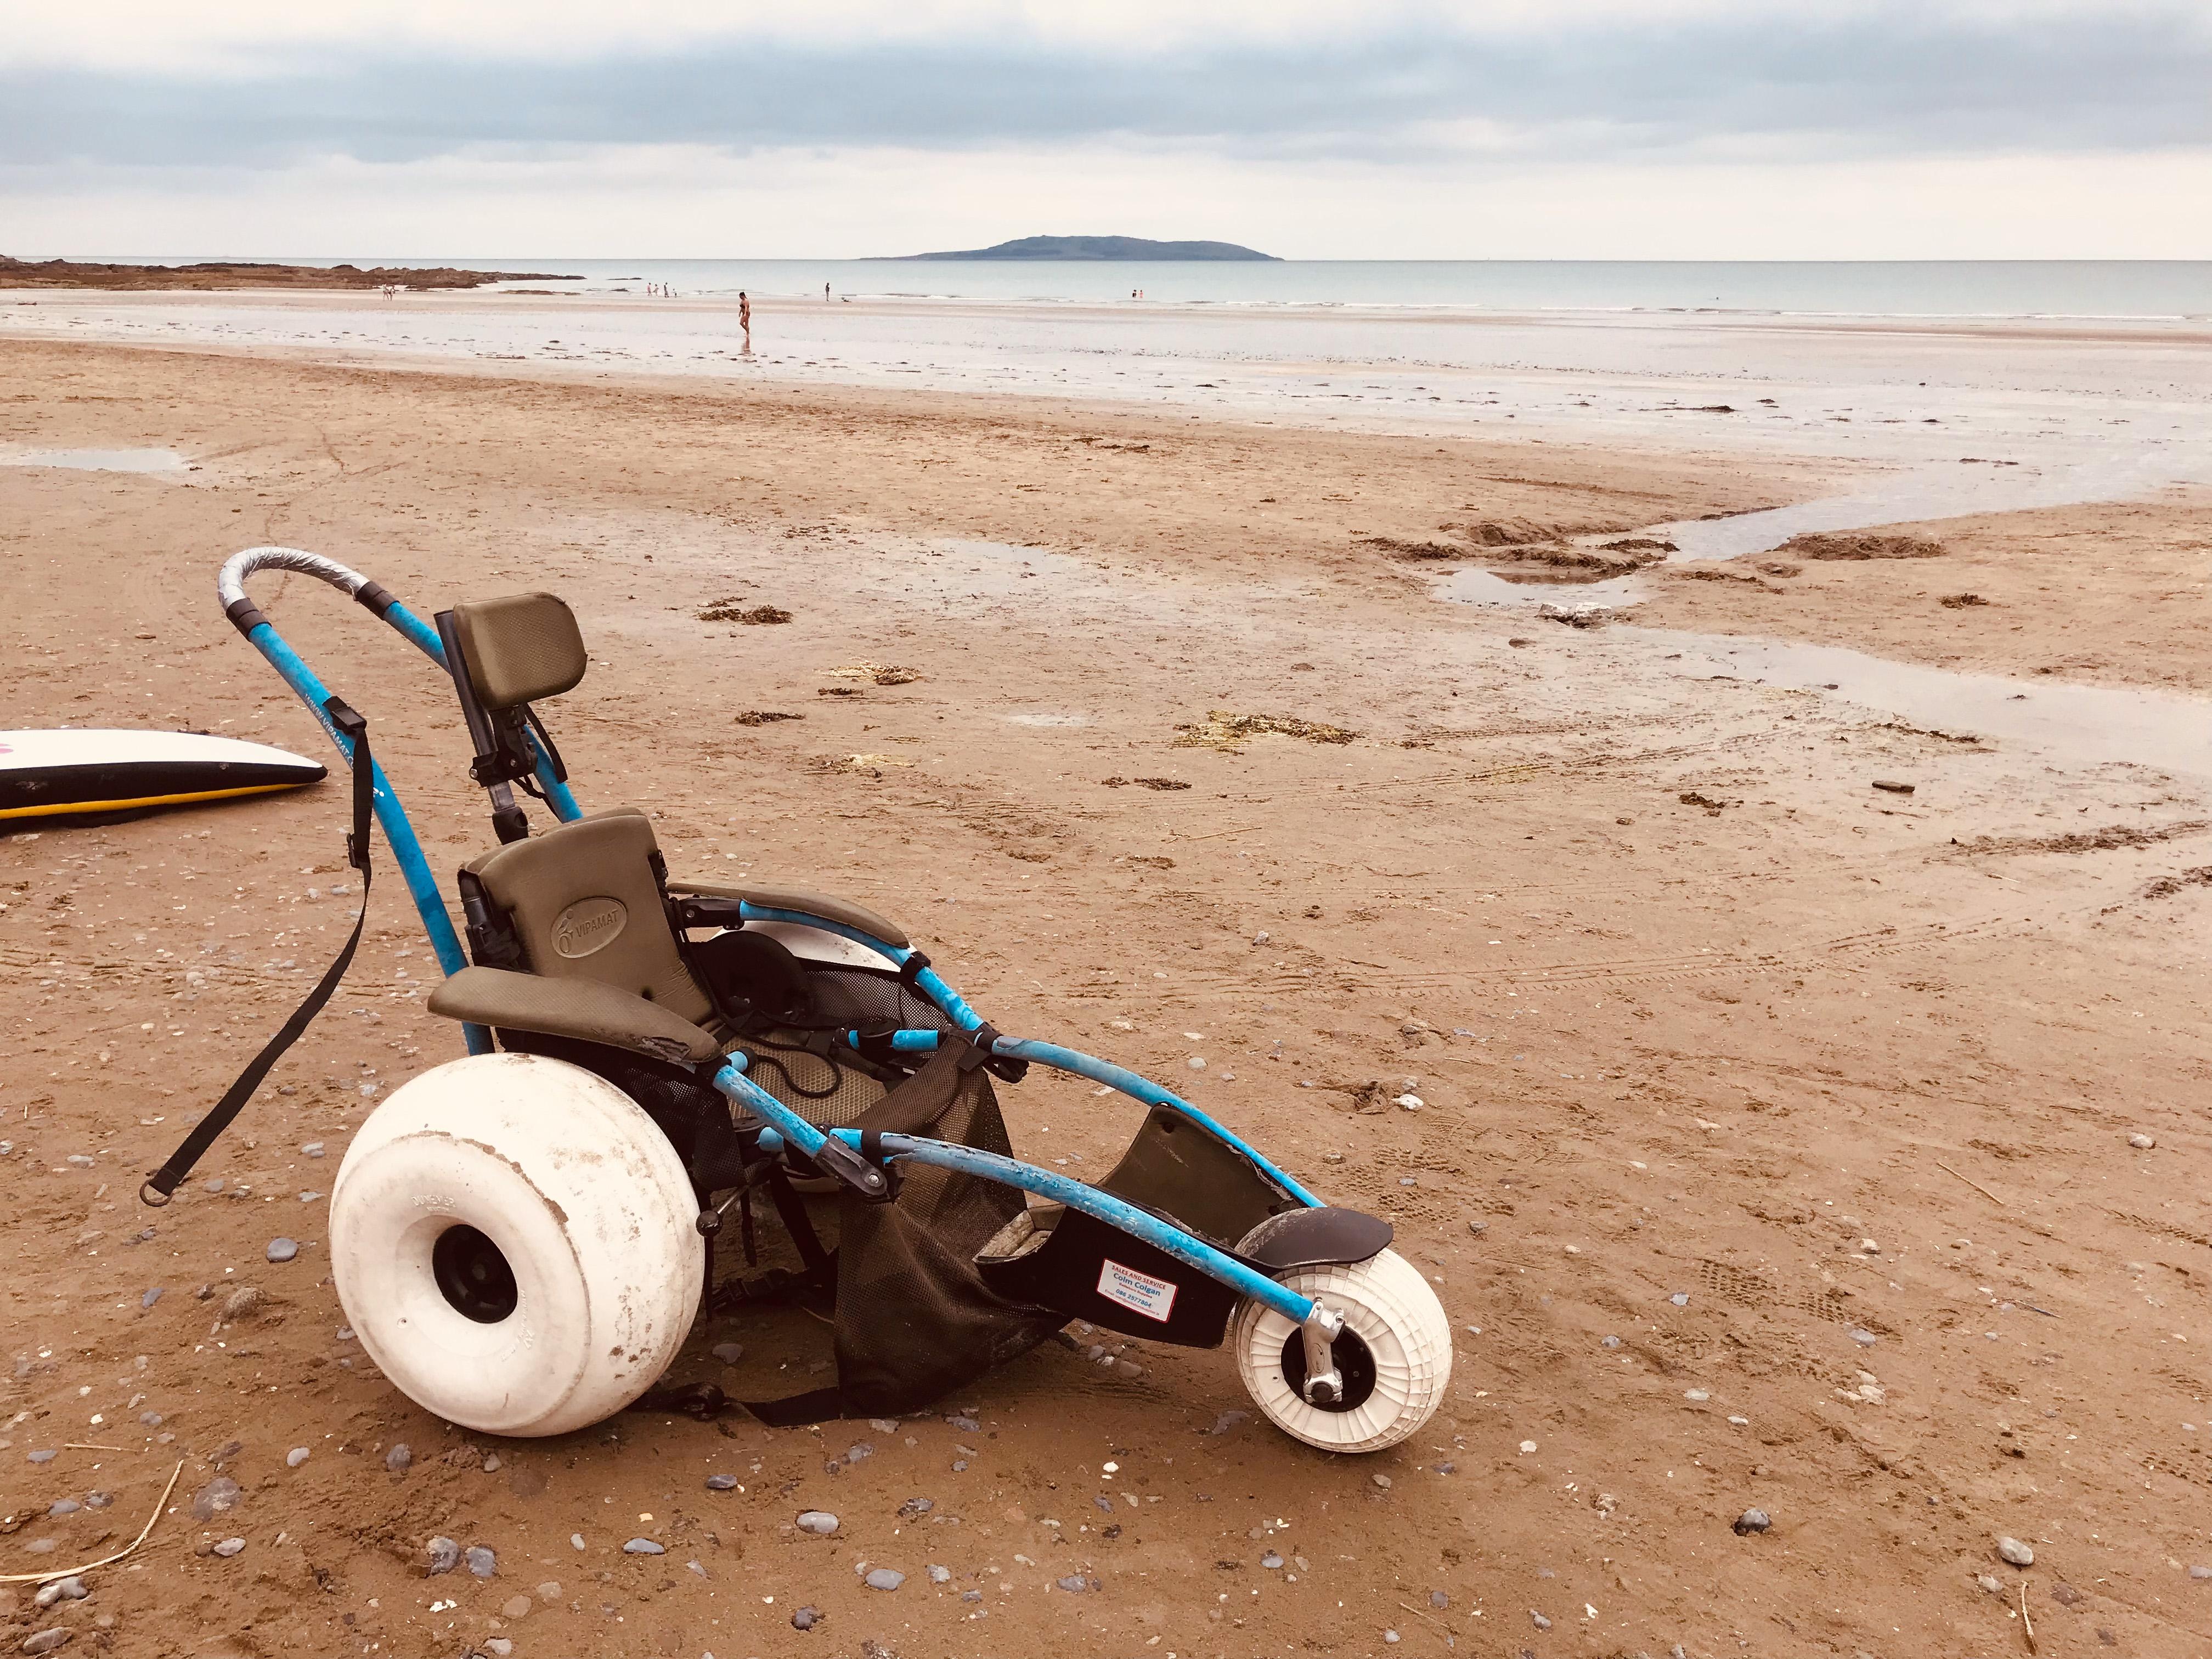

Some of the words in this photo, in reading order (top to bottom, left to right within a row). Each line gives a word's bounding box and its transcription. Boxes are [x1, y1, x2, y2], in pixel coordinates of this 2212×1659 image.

[576, 909, 618, 937] VIPAMAT
[1111, 1265, 1128, 1275] SALES
[1129, 1273, 1142, 1281] AND
[1143, 1278, 1166, 1290] SERVICE
[1114, 1273, 1132, 1285] Colm
[1135, 1282, 1161, 1296] Colgan
[1115, 1289, 1126, 1297] 086
[1127, 1294, 1152, 1308] 2577804
